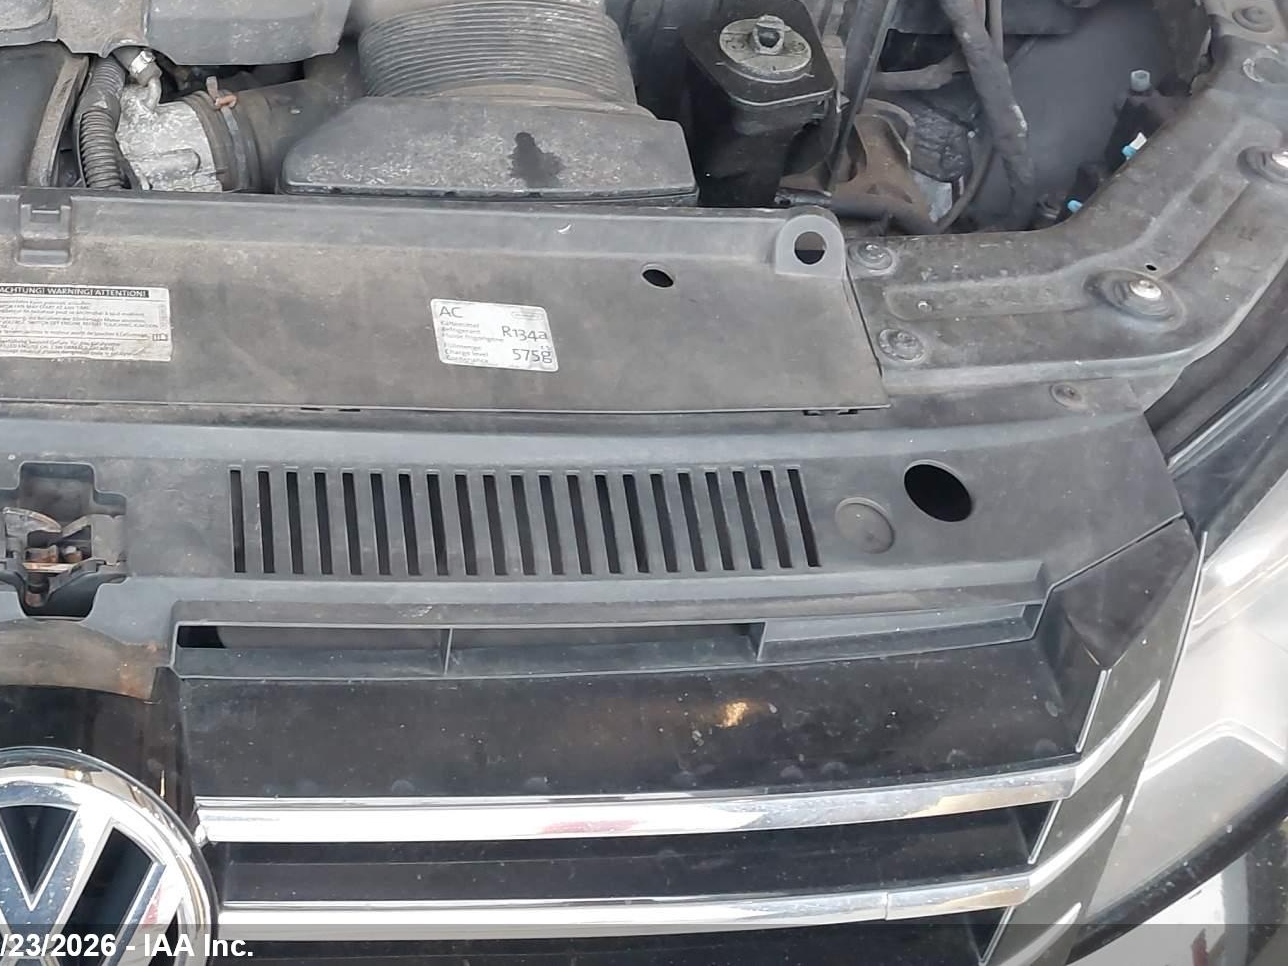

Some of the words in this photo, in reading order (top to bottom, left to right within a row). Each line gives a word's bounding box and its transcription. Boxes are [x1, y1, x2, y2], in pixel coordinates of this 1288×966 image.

[47, 287, 93, 296] WARNING!
[94, 288, 147, 298] ATTENTION!
[440, 305, 464, 318] AC
[501, 325, 549, 342] R134a
[512, 348, 553, 364] 575g
